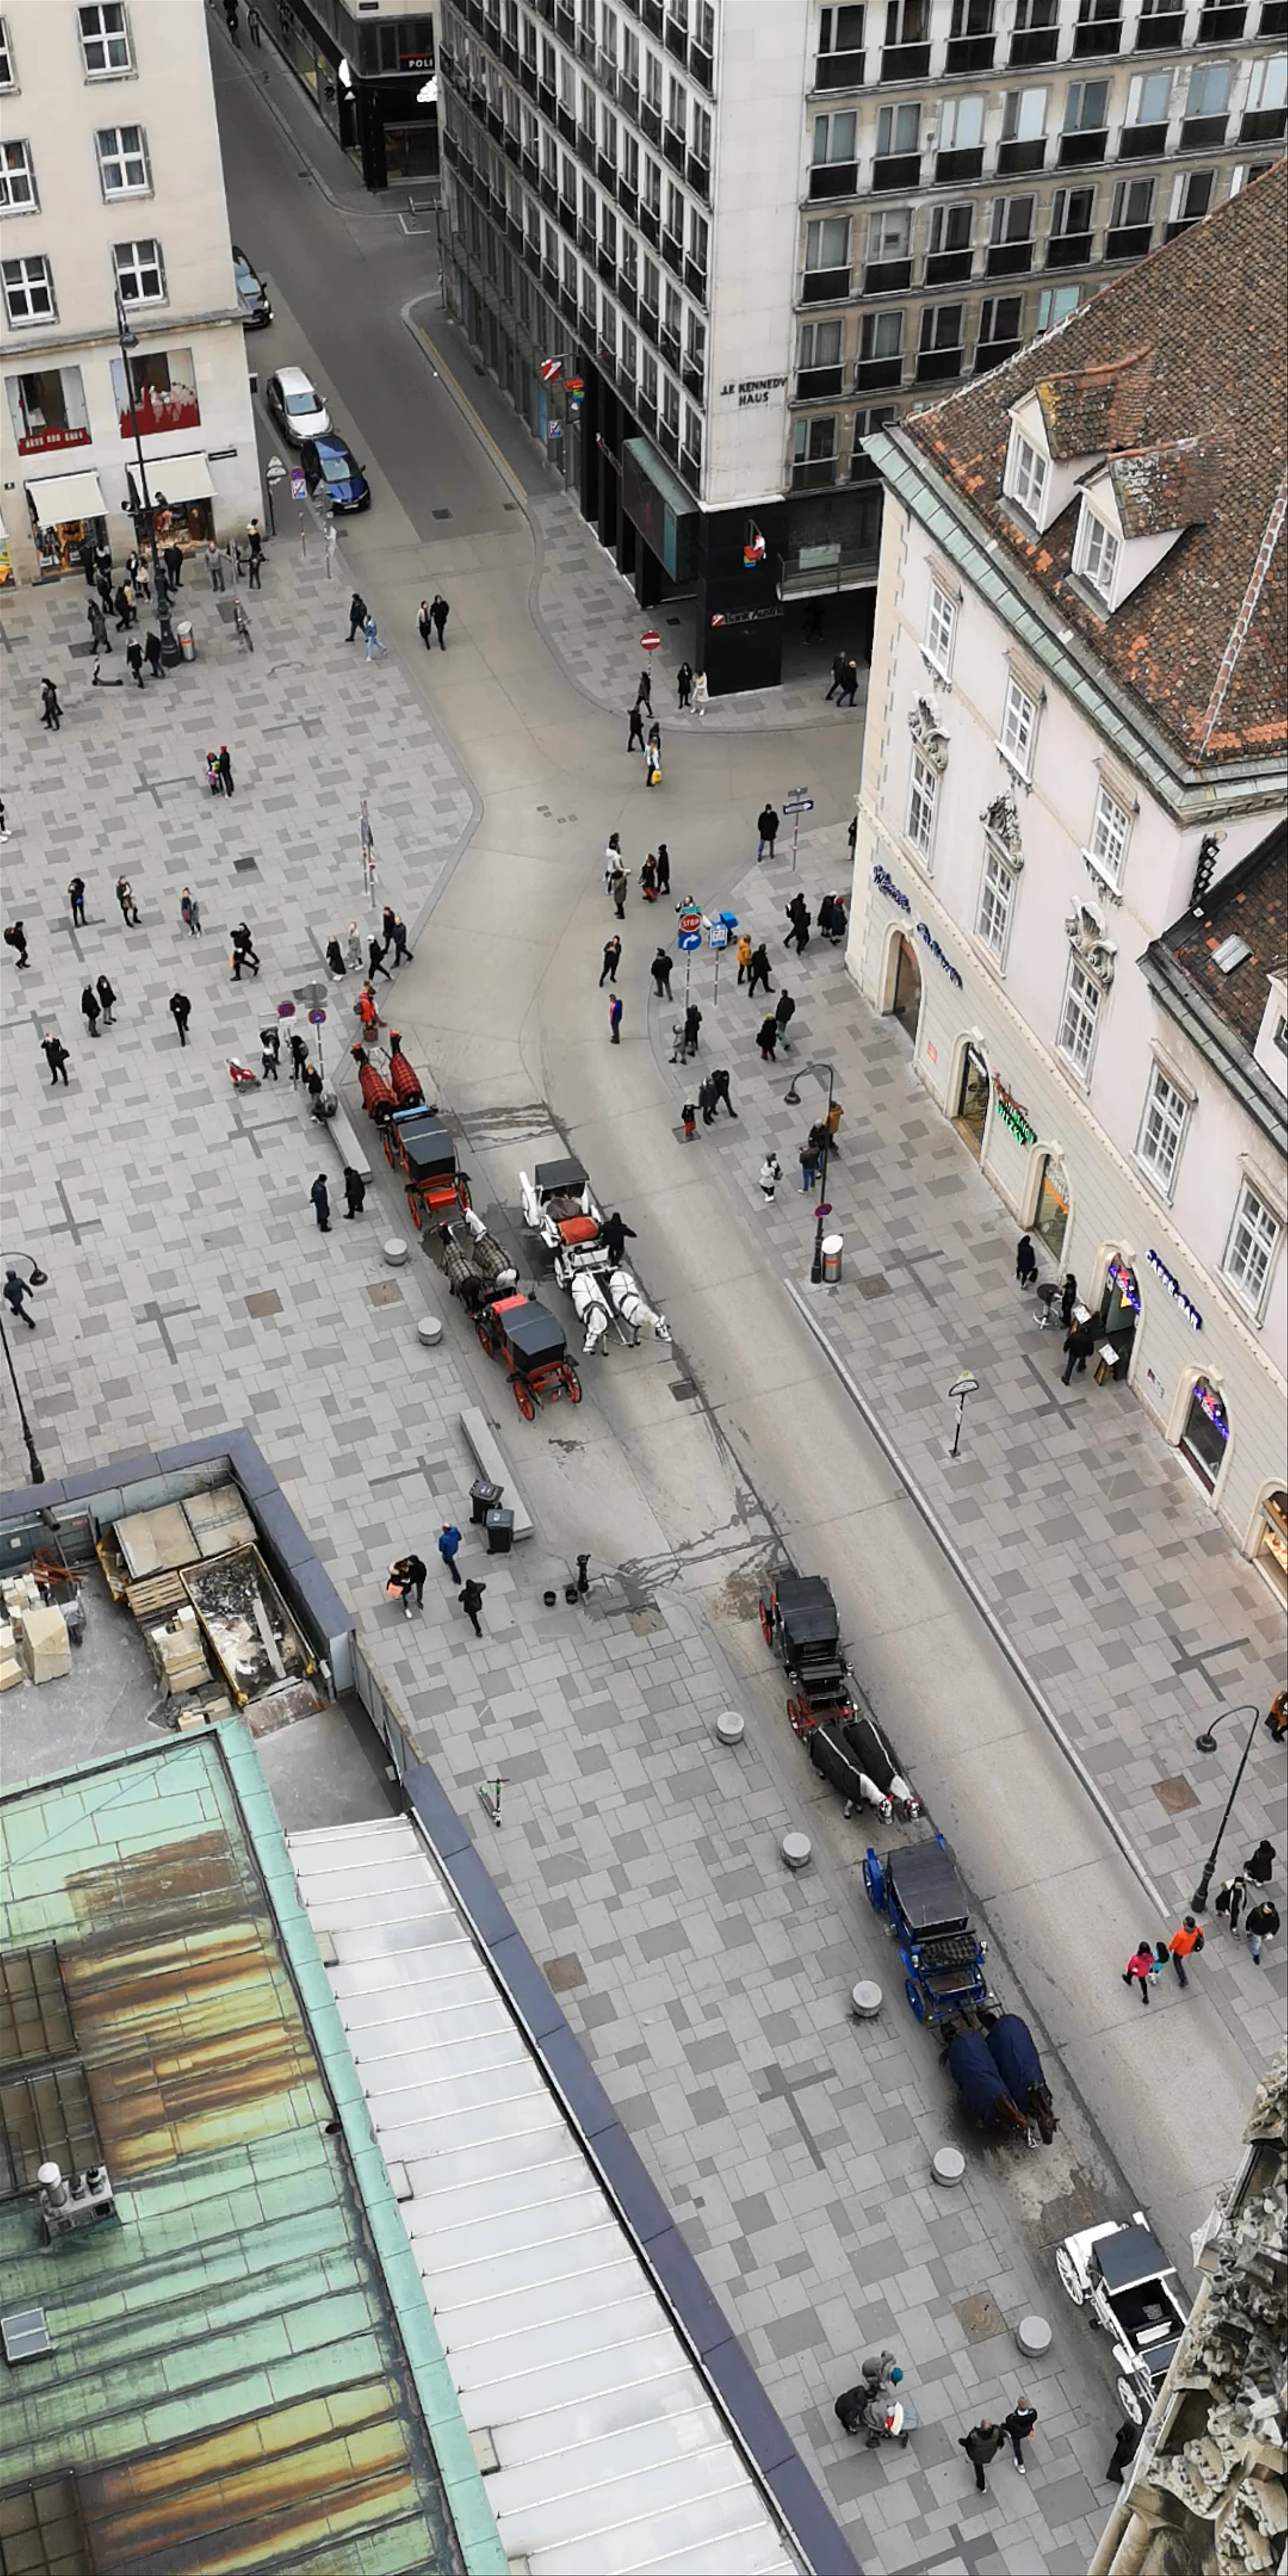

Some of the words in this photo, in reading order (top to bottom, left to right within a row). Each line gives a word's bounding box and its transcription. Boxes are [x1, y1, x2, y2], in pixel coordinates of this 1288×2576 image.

[739, 377, 788, 393] KENNEDY
[739, 392, 769, 406] HAUS
[682, 918, 699, 927] STOP
